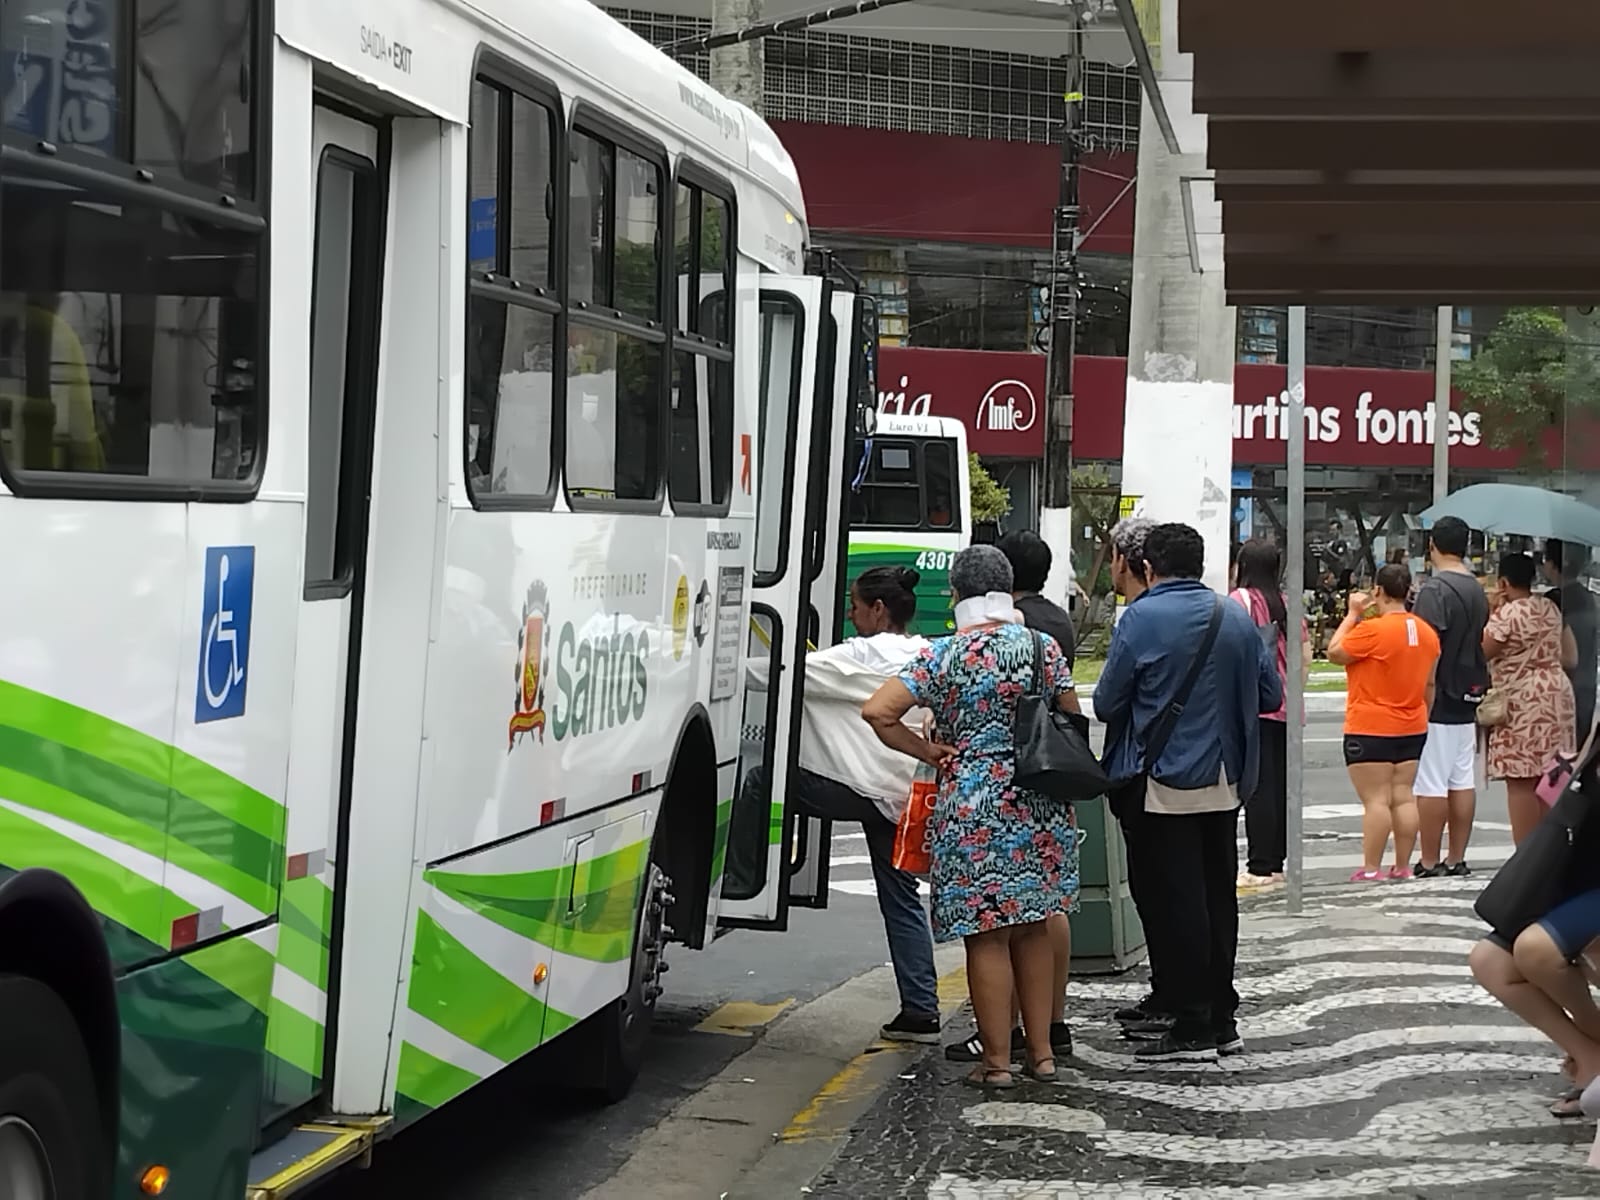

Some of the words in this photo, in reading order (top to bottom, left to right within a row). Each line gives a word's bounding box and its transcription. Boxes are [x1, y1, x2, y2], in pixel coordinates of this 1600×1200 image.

[393, 41, 412, 75] EXIT
[1355, 392, 1482, 446] fontes
[552, 612, 650, 742] Santos
